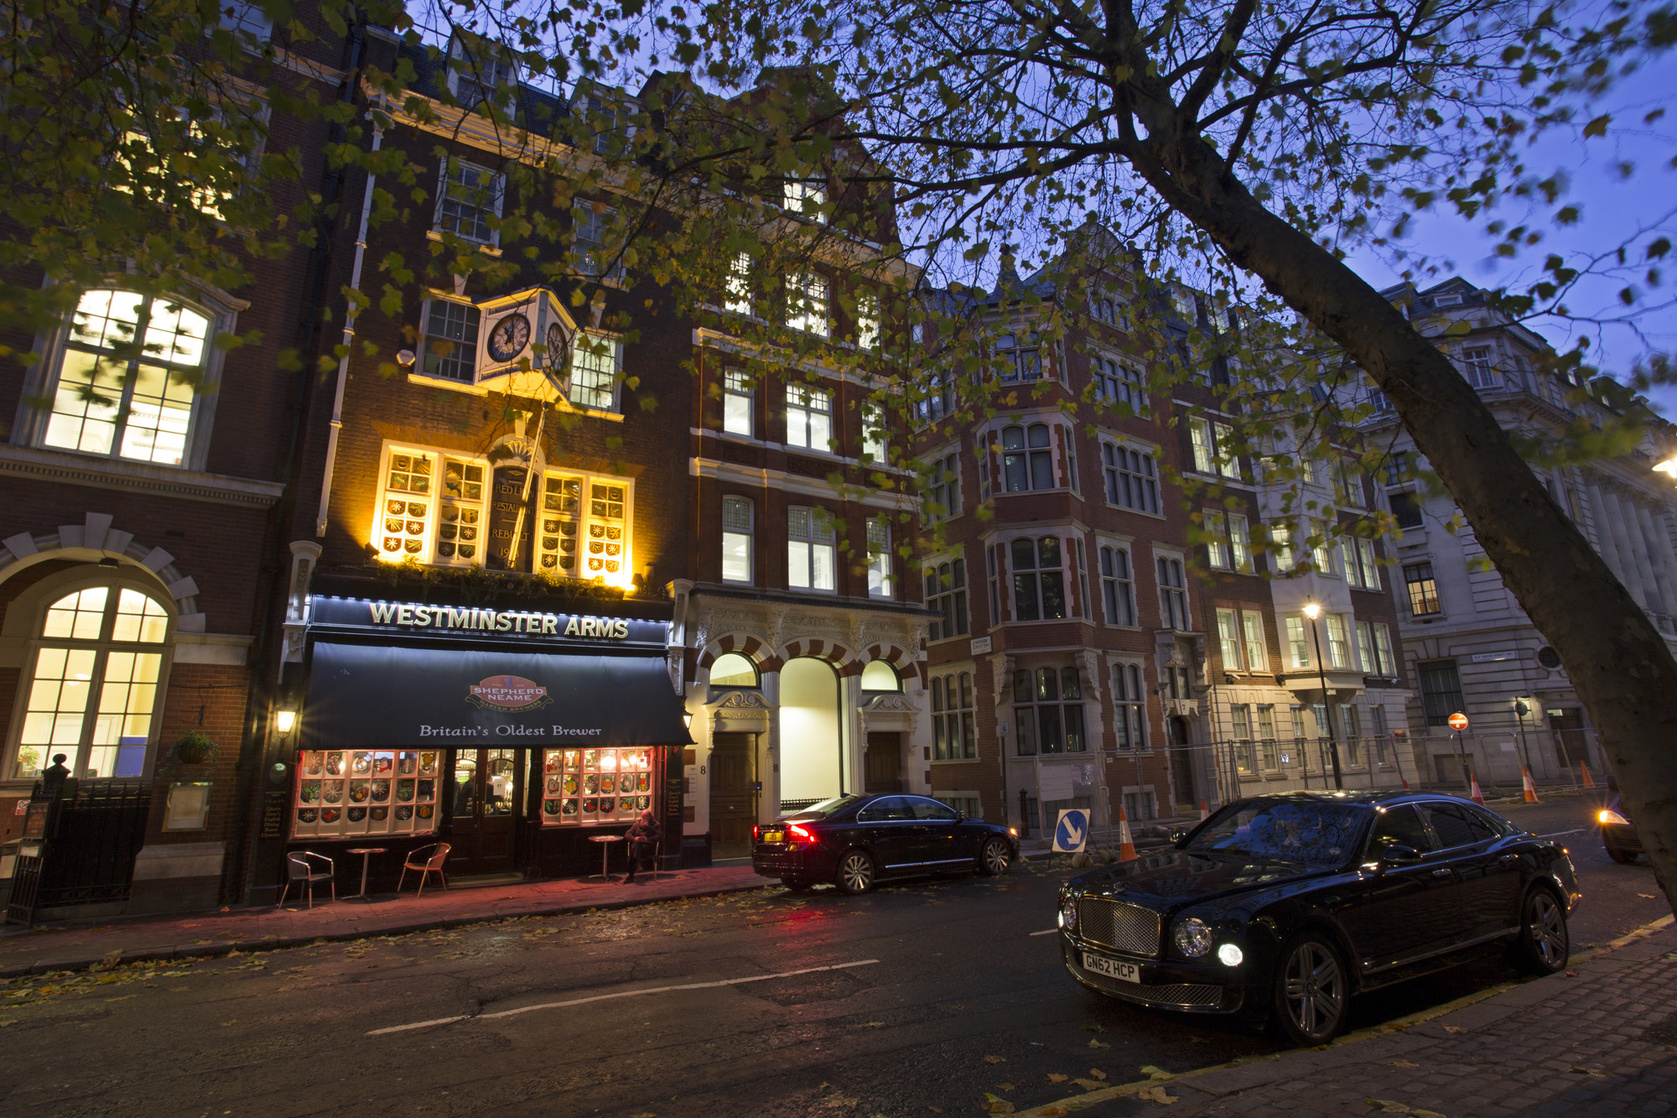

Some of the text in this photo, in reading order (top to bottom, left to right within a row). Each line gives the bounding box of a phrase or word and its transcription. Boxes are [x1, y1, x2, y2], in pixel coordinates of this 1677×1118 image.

[495, 484, 535, 498] RED LIN
[492, 529, 530, 541] REBULT
[368, 603, 629, 639] WESTMINSTER ARMS
[474, 687, 544, 695] SHEPHERD
[419, 724, 602, 737] Britain's Oldest Brewer
[700, 766, 706, 774] 8
[773, 764, 778, 773] 8
[1086, 955, 1135, 978] GN62 HCP
